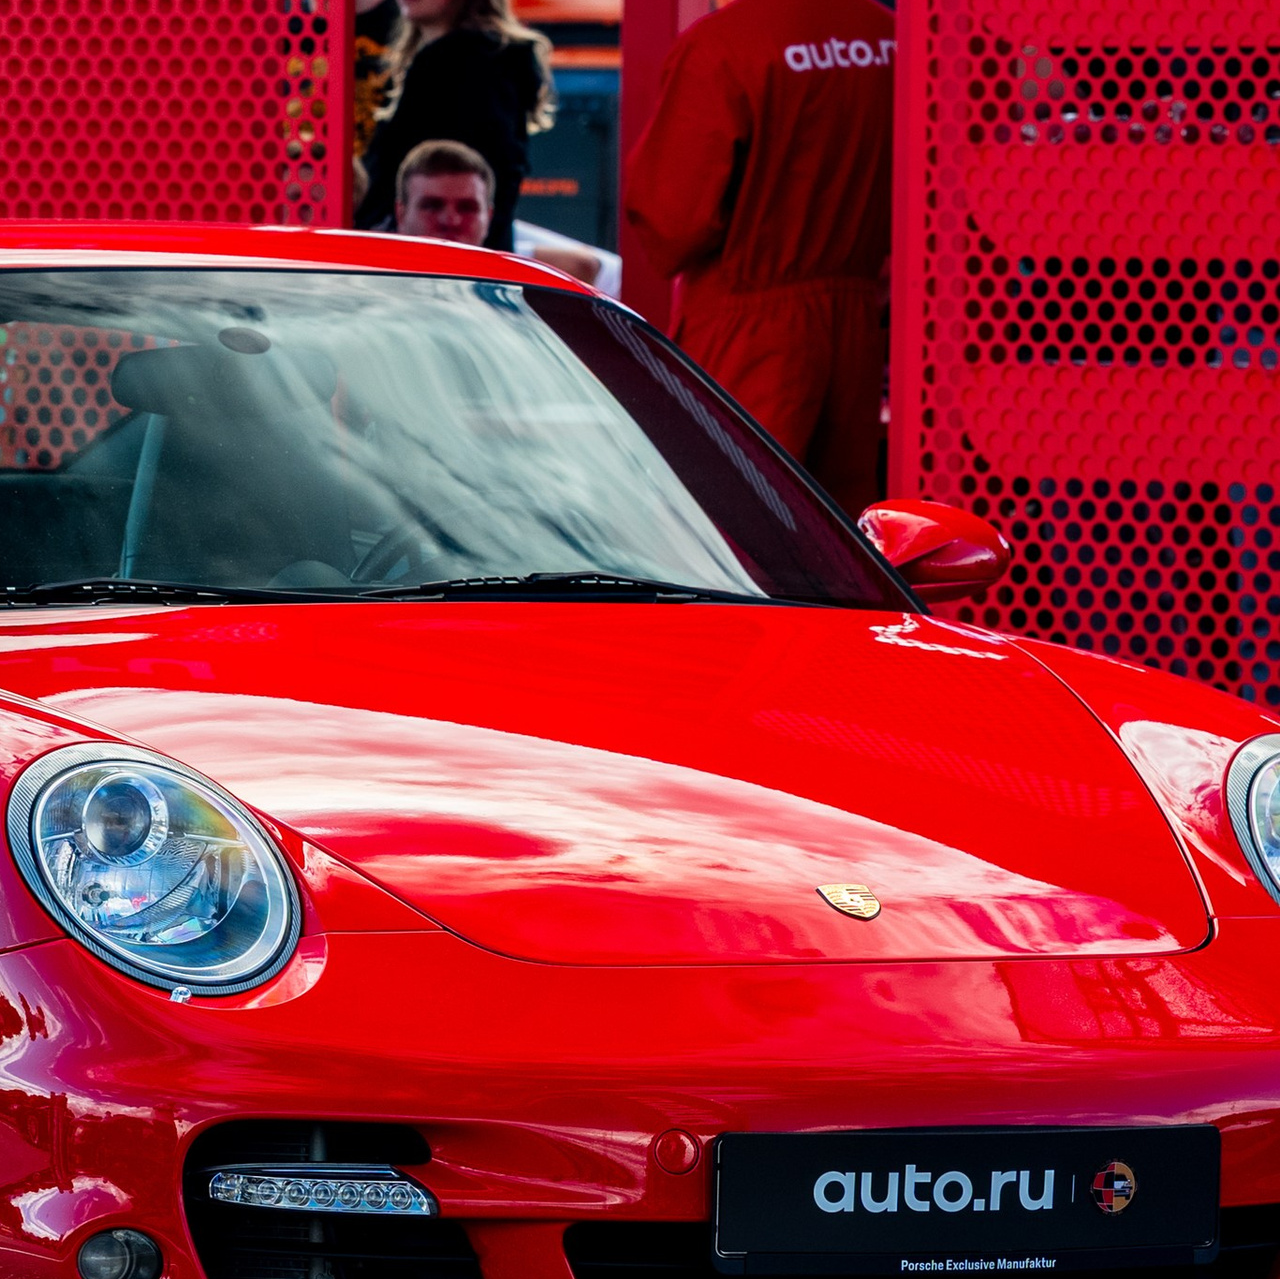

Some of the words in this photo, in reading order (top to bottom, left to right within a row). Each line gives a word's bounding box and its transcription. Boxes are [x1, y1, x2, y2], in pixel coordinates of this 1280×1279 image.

[784, 37, 897, 72] auto.r
[813, 1164, 1055, 1213] auto.ru
[901, 1259, 944, 1271] Porsche
[946, 1259, 995, 1271] Exclusive
[997, 1257, 1057, 1270] Manufaktur
